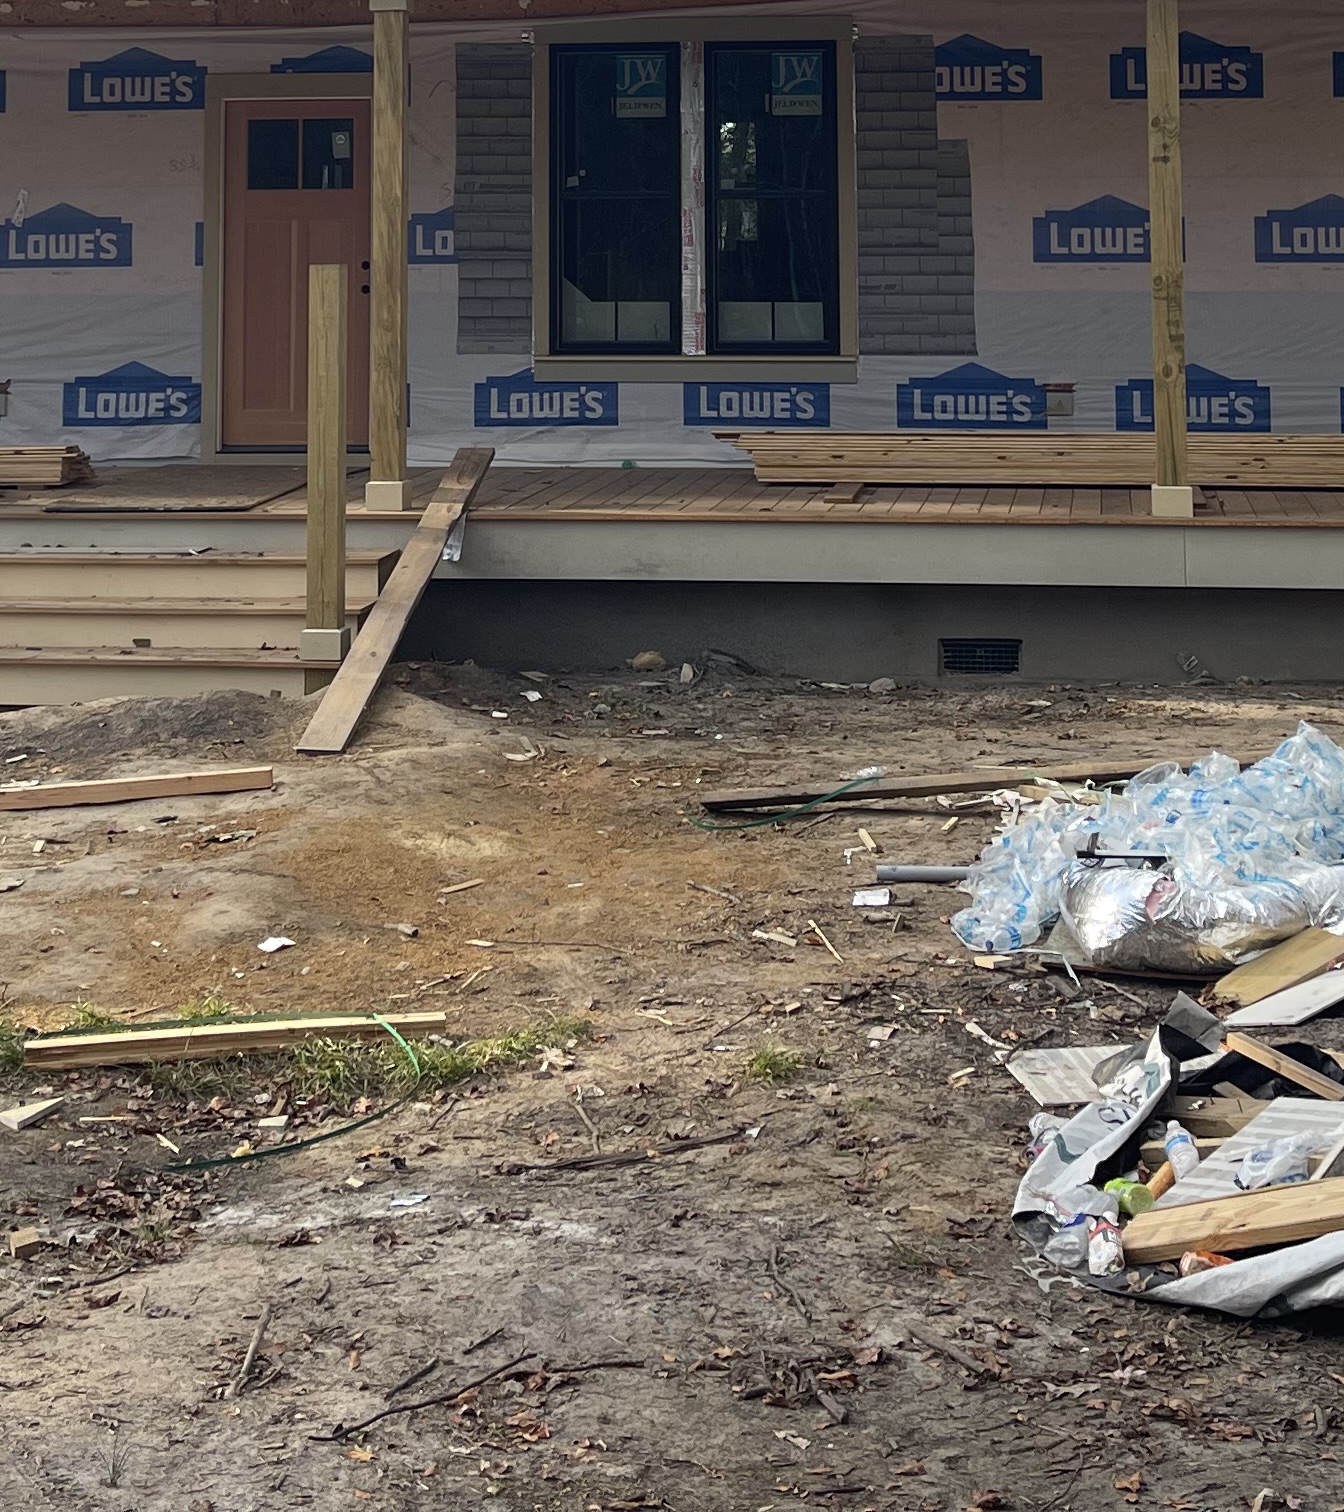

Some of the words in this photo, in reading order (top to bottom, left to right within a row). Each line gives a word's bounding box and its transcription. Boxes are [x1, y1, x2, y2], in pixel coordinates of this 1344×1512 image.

[83, 72, 194, 104] LOWE'S
[616, 58, 665, 91] JW
[771, 55, 820, 88] JW
[936, 61, 1028, 92] OWE'S
[1126, 58, 1247, 92] LWE'S
[8, 228, 118, 260] LOWE'S
[1050, 222, 1150, 255] LOWE'
[78, 387, 188, 418] LOWE'S
[489, 386, 603, 419] LOWE'S
[699, 386, 815, 419] LOWE'S
[913, 389, 1033, 422] LOWE'S
[1133, 390, 1254, 424] LWE'S
